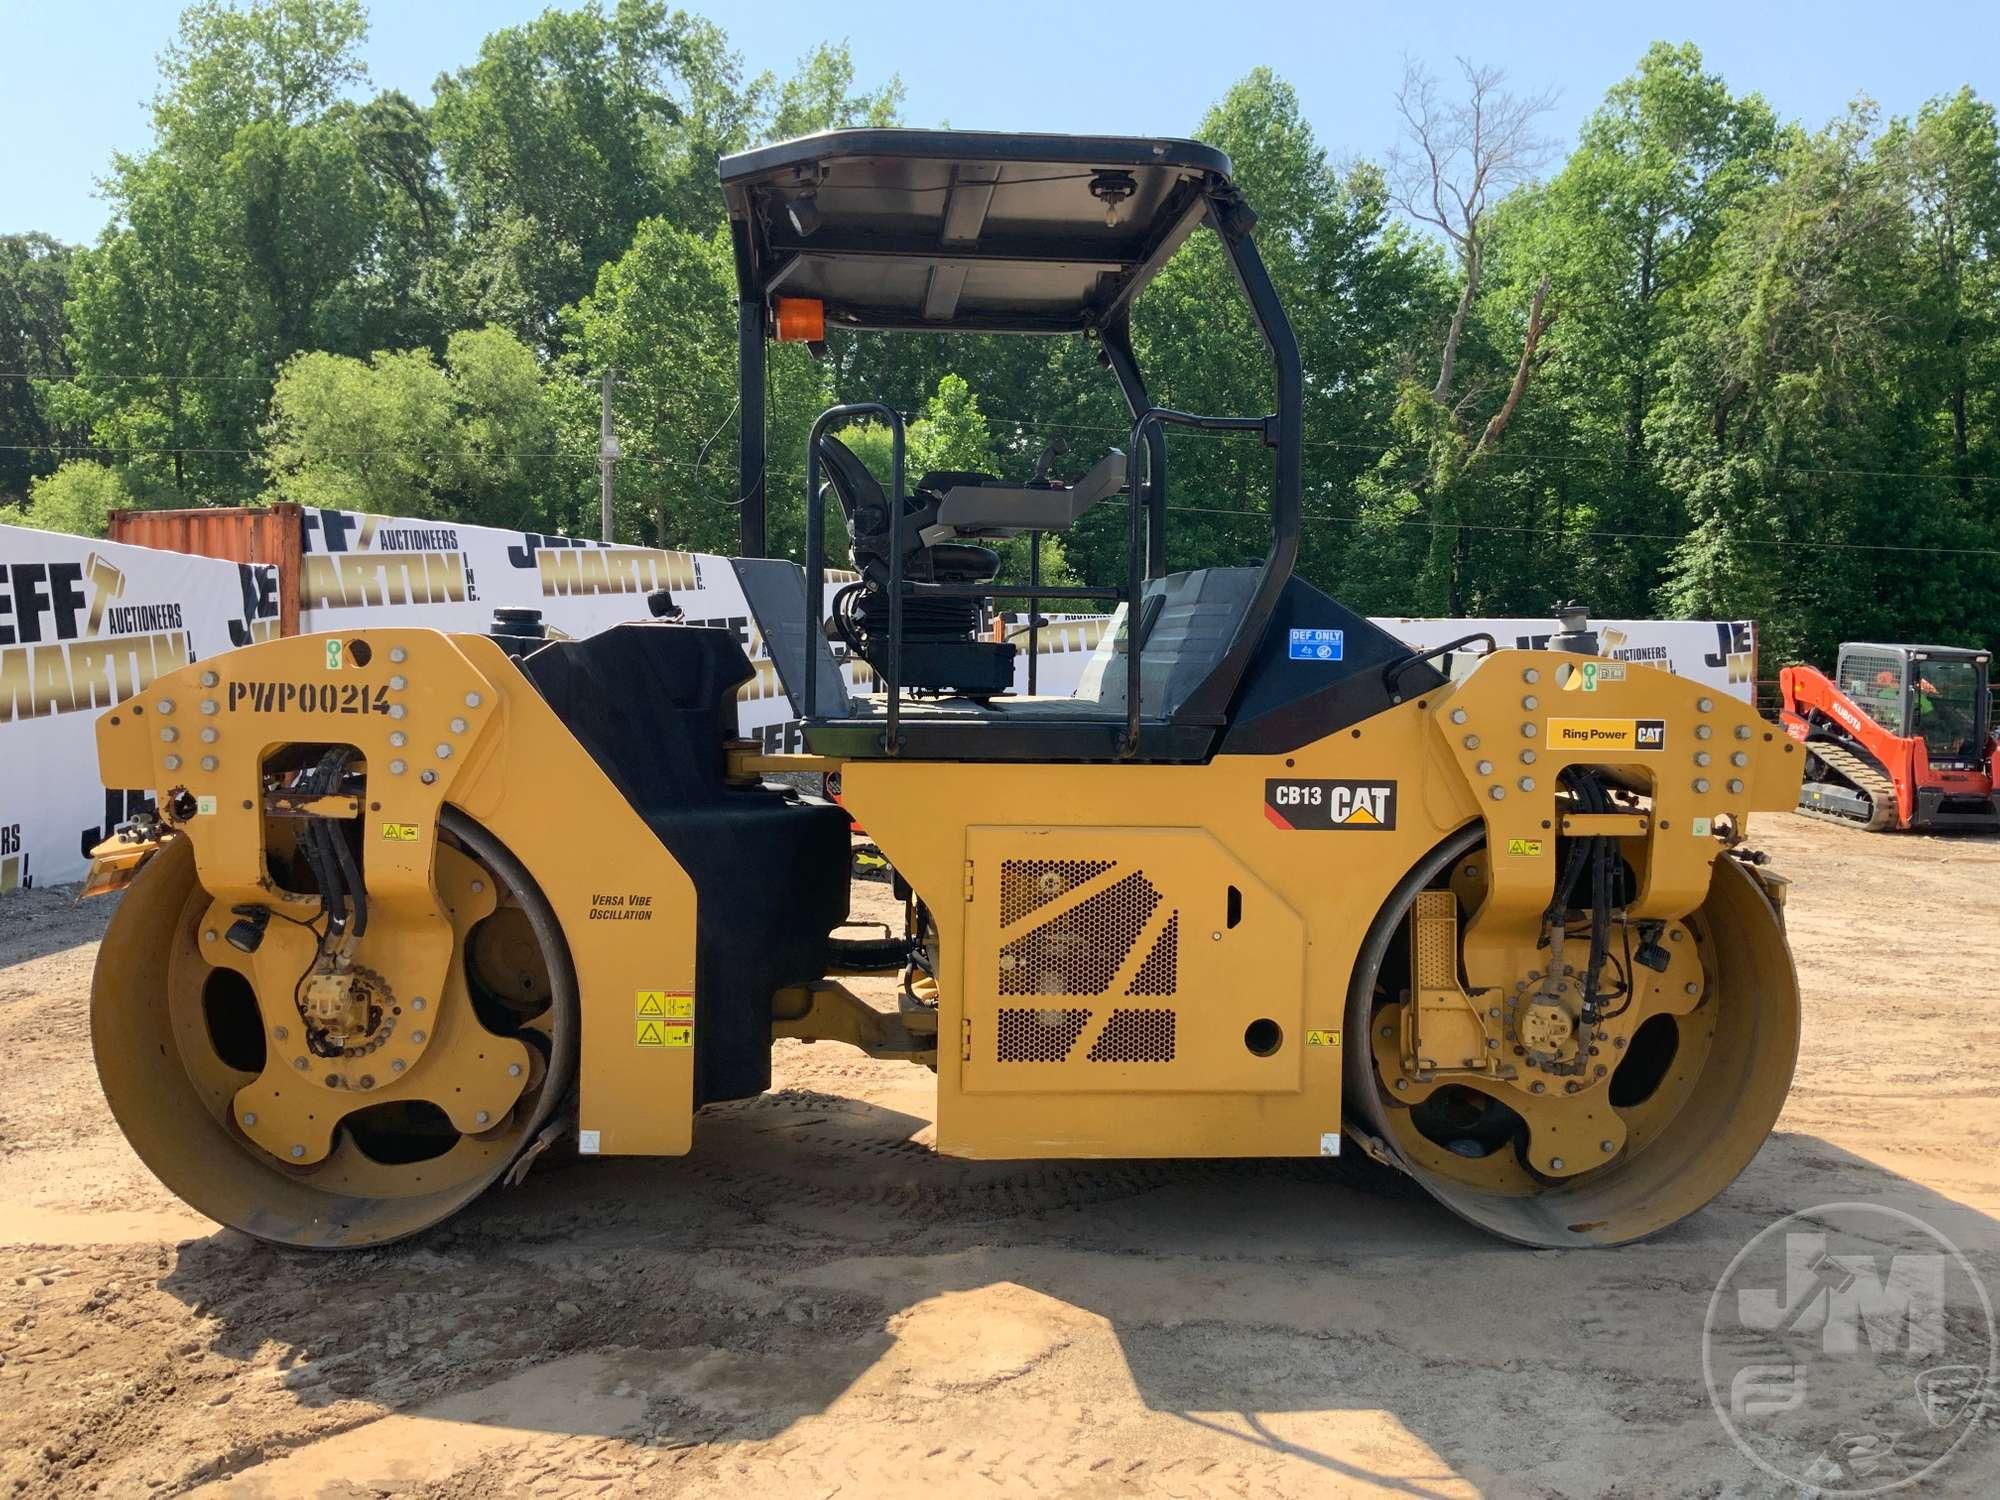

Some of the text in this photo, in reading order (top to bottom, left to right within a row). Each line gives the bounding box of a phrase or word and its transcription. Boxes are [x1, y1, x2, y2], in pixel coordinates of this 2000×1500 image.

[379, 529, 459, 551] AUCTIONEERS
[301, 552, 466, 611] ARTIN
[537, 549, 696, 597] MARTIN
[108, 602, 183, 635] AUCTIONEERS
[1292, 631, 1341, 641] DEF ONLY
[1612, 646, 1668, 662] AUCTIONEERS
[228, 681, 391, 715] PWP00214
[1832, 702, 1862, 733] KUBOTA
[1562, 726, 1664, 744] Ring Power CAT
[1275, 785, 1391, 824] CB13 CAT
